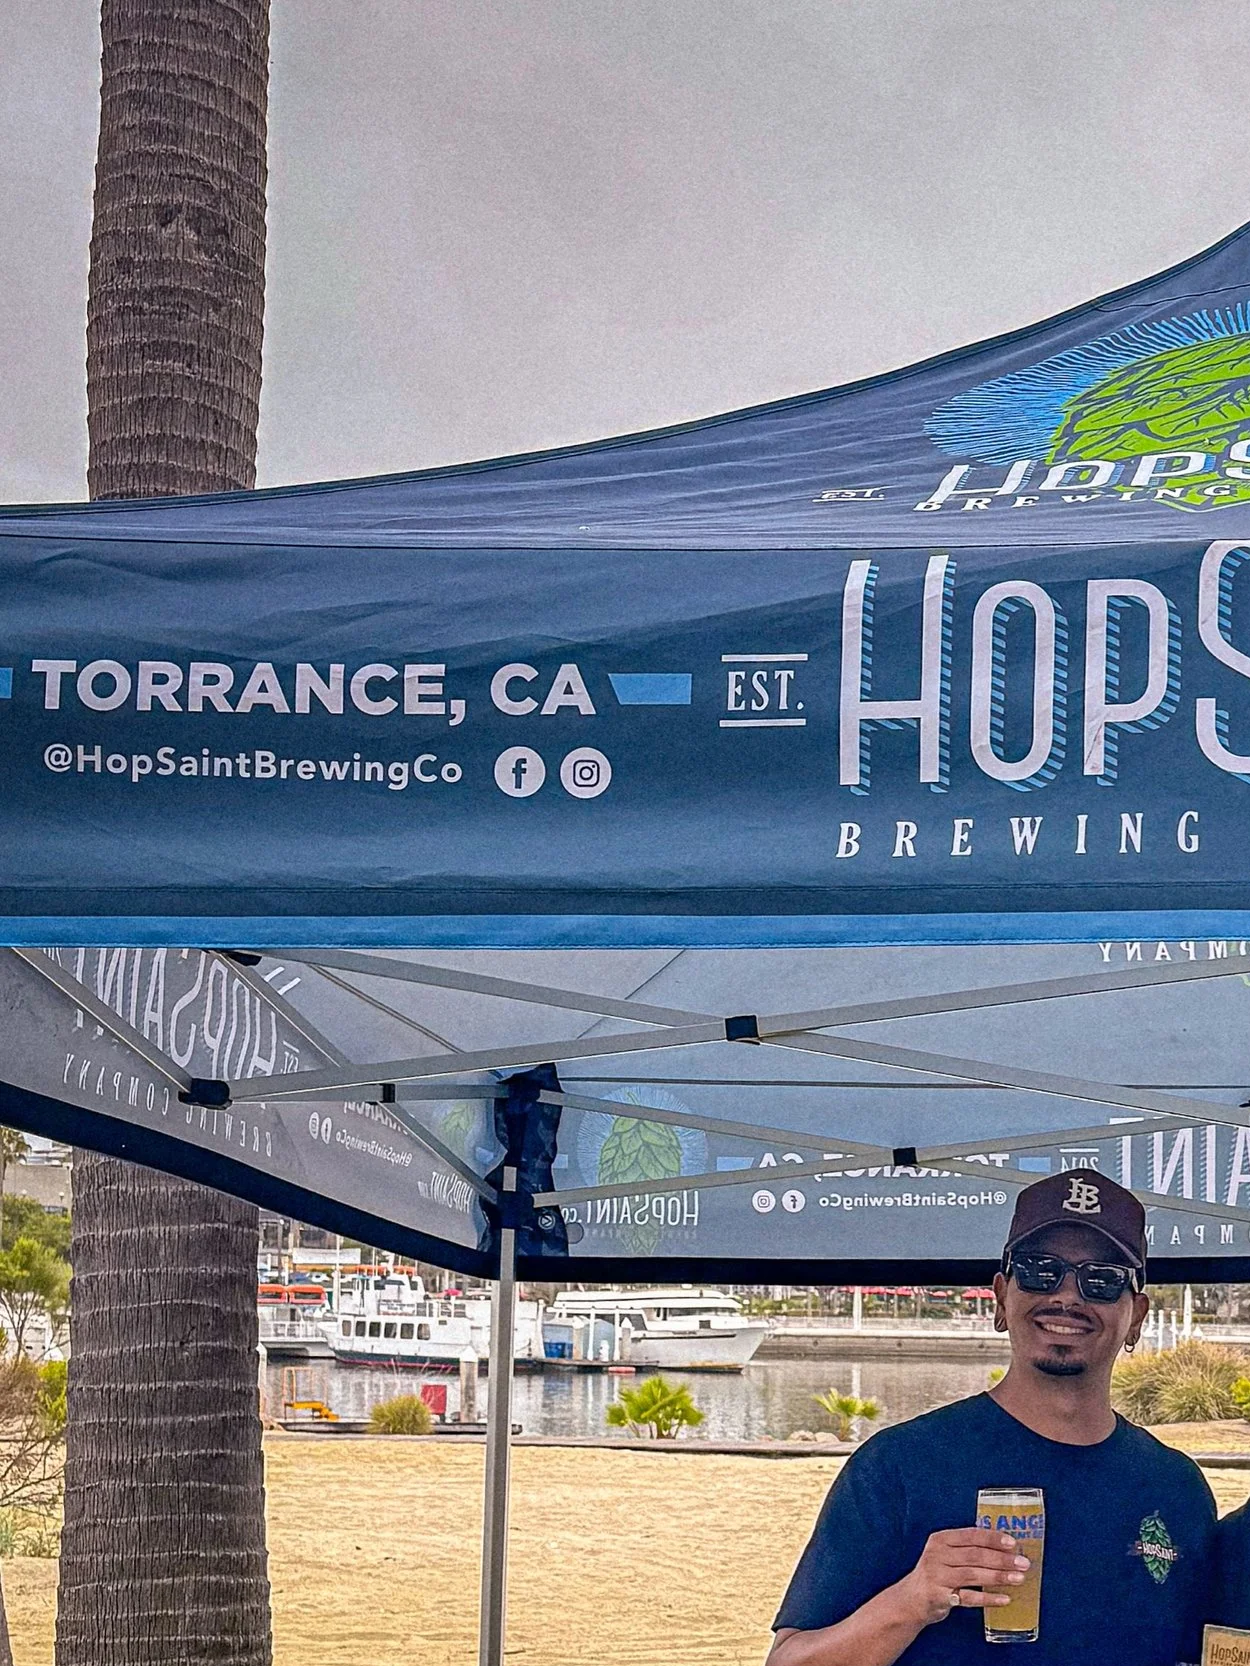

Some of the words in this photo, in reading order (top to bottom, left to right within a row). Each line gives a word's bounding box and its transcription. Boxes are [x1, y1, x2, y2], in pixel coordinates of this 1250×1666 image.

[913, 484, 1242, 512] BREWING
[32, 660, 467, 726] TORRANCE,
[490, 663, 596, 717] CA
[727, 671, 804, 711] EST.
[43, 744, 463, 791] @HopSaintBrewingCo
[836, 812, 1202, 859] BREWING
